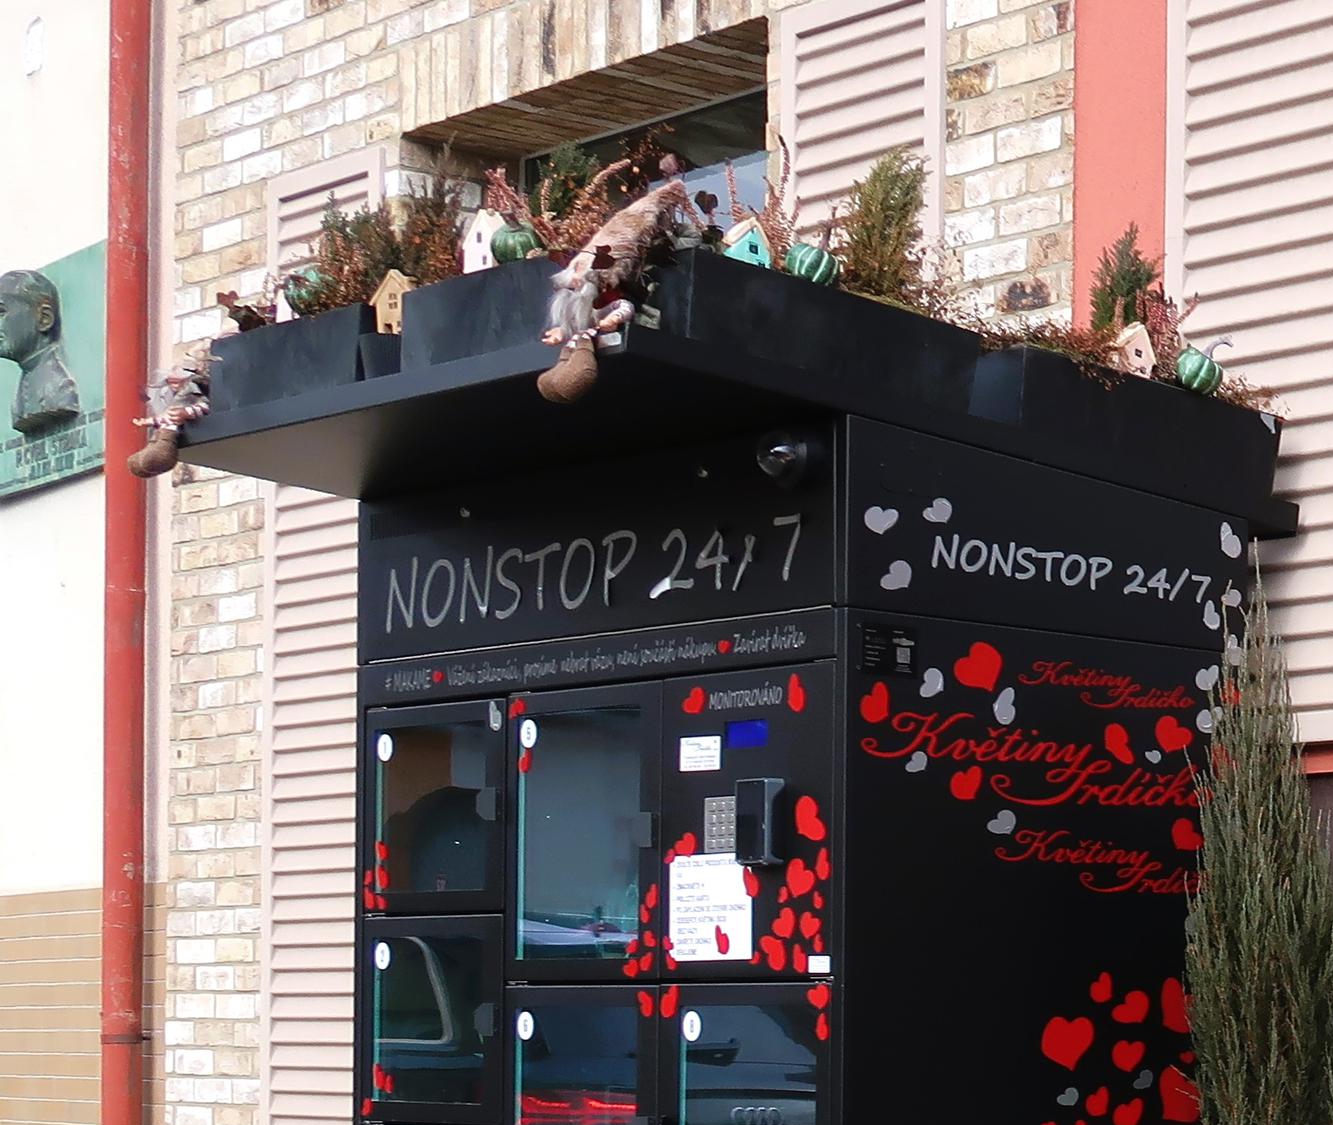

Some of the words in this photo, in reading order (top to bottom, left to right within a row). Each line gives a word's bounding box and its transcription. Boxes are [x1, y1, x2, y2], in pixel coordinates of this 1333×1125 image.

[386, 529, 639, 633] NONSTOP
[648, 513, 802, 601] 24/7
[930, 533, 1113, 590] NONSTOP
[1122, 563, 1213, 604] 24/7
[1017, 659, 1134, 690] Květiny
[859, 711, 1093, 764] Květiny
[993, 829, 1152, 866] Květiny
